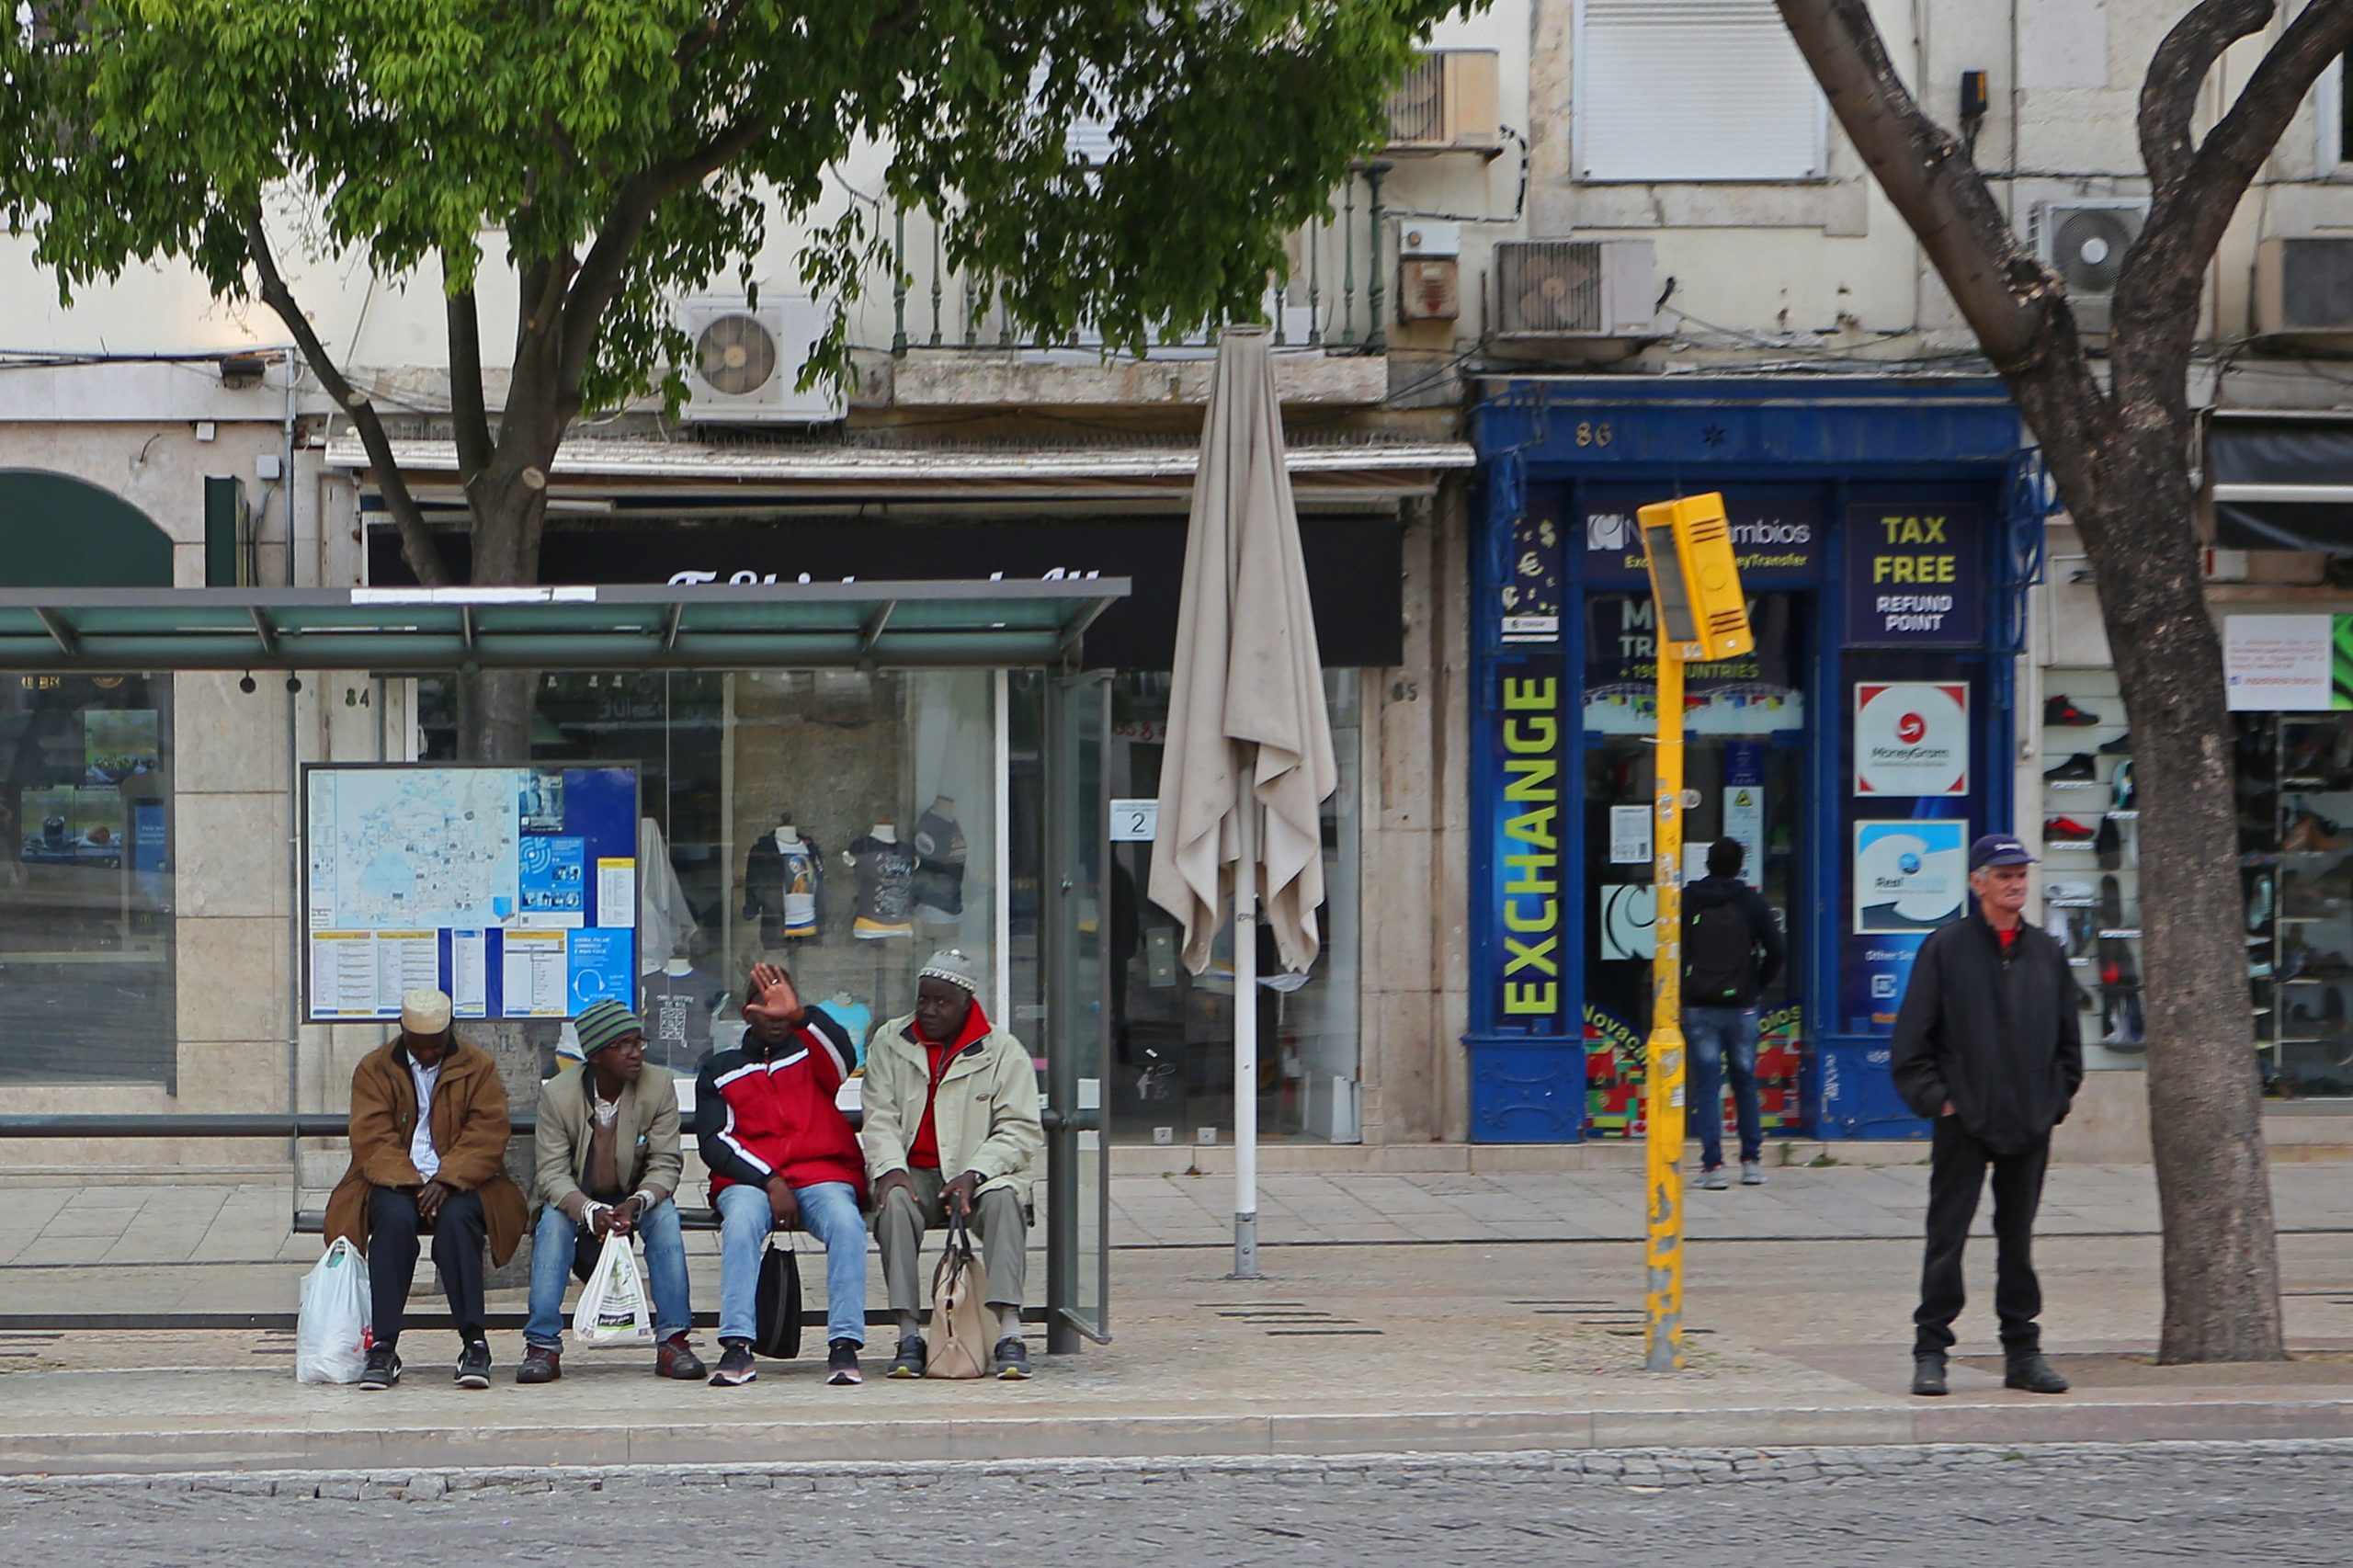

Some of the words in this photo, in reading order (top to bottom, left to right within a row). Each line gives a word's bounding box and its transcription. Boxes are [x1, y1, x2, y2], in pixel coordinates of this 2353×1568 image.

[1575, 422, 1611, 448] 86
[1625, 518, 1811, 545] Nmbios
[1881, 517, 1947, 544] TAX
[1873, 555, 1956, 584] FREE
[1876, 595, 1953, 613] REFUND
[1885, 613, 1944, 632] POINT
[1688, 664, 1759, 679] UNTRIES
[346, 687, 369, 708] 84
[1131, 812, 1146, 833] 2
[1503, 676, 1559, 1015] EXCHANGE
